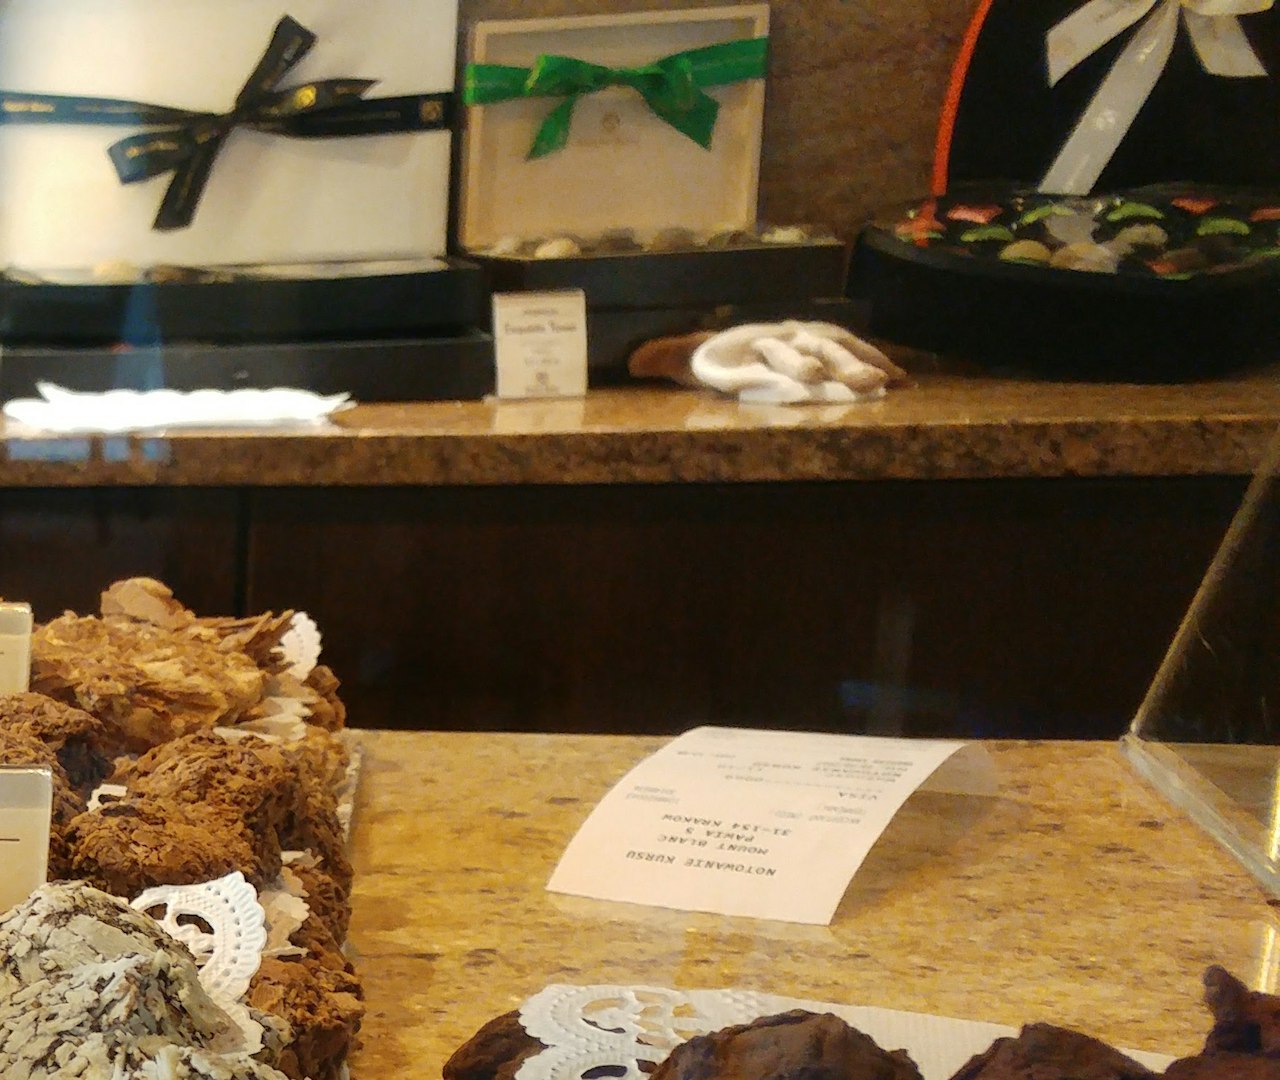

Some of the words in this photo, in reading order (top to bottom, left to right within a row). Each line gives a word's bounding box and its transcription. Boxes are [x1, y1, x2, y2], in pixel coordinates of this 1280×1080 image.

[662, 814, 722, 827] KRAKOW
[657, 834, 707, 847] BLANC
[706, 830, 755, 842] PAWIA
[717, 843, 769, 855] MOUNT
[626, 850, 676, 864] KURSU
[684, 858, 776, 876] NOTOWANIE
